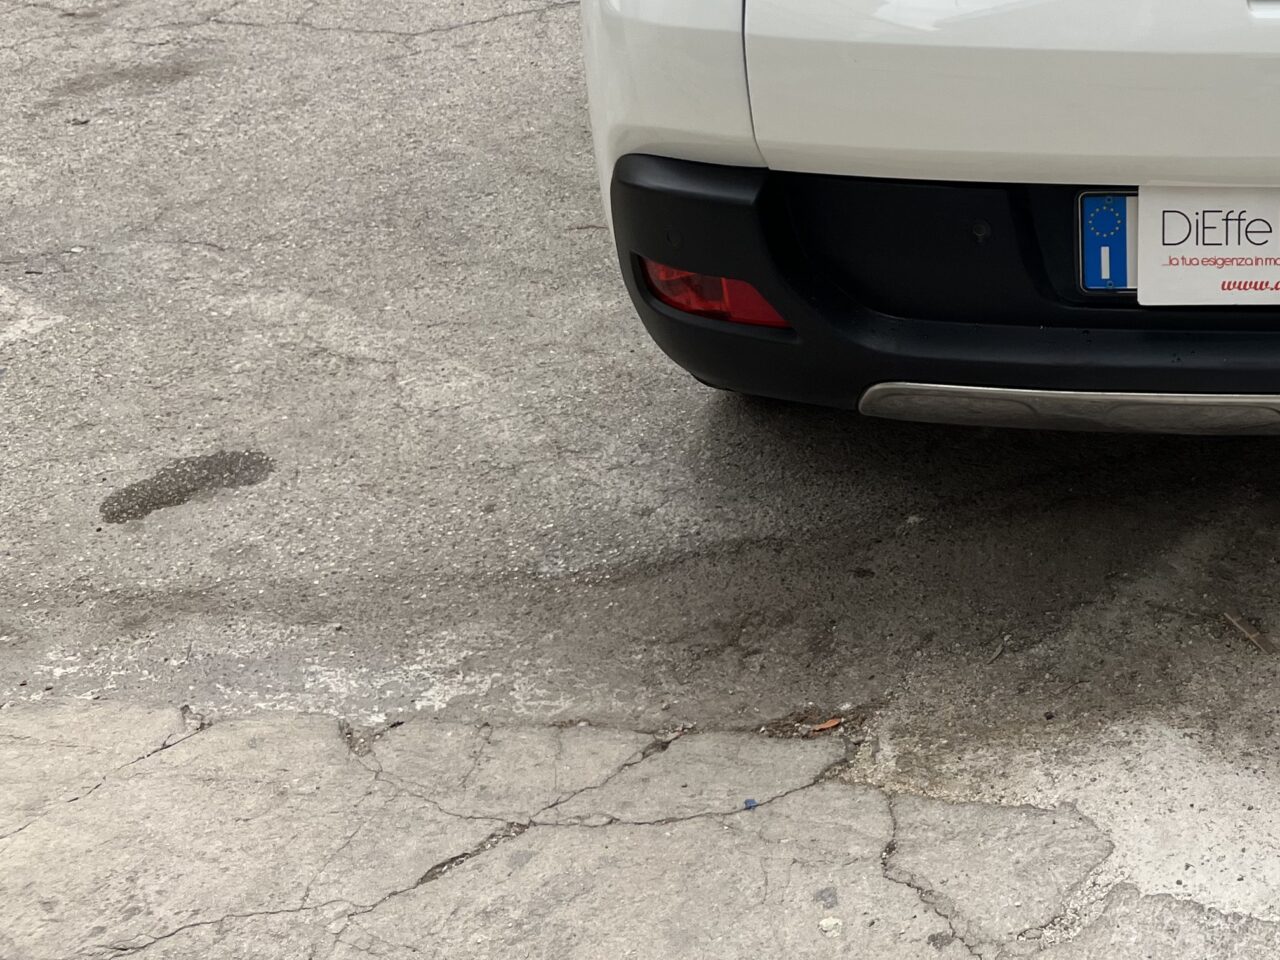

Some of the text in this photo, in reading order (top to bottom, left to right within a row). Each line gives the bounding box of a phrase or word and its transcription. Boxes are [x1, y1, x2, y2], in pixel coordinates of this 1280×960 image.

[1162, 210, 1273, 246] DiEffe
[1101, 246, 1110, 279] I
[1181, 256, 1200, 266] tua
[1201, 255, 1253, 269] esigenza
[1254, 256, 1265, 266] in
